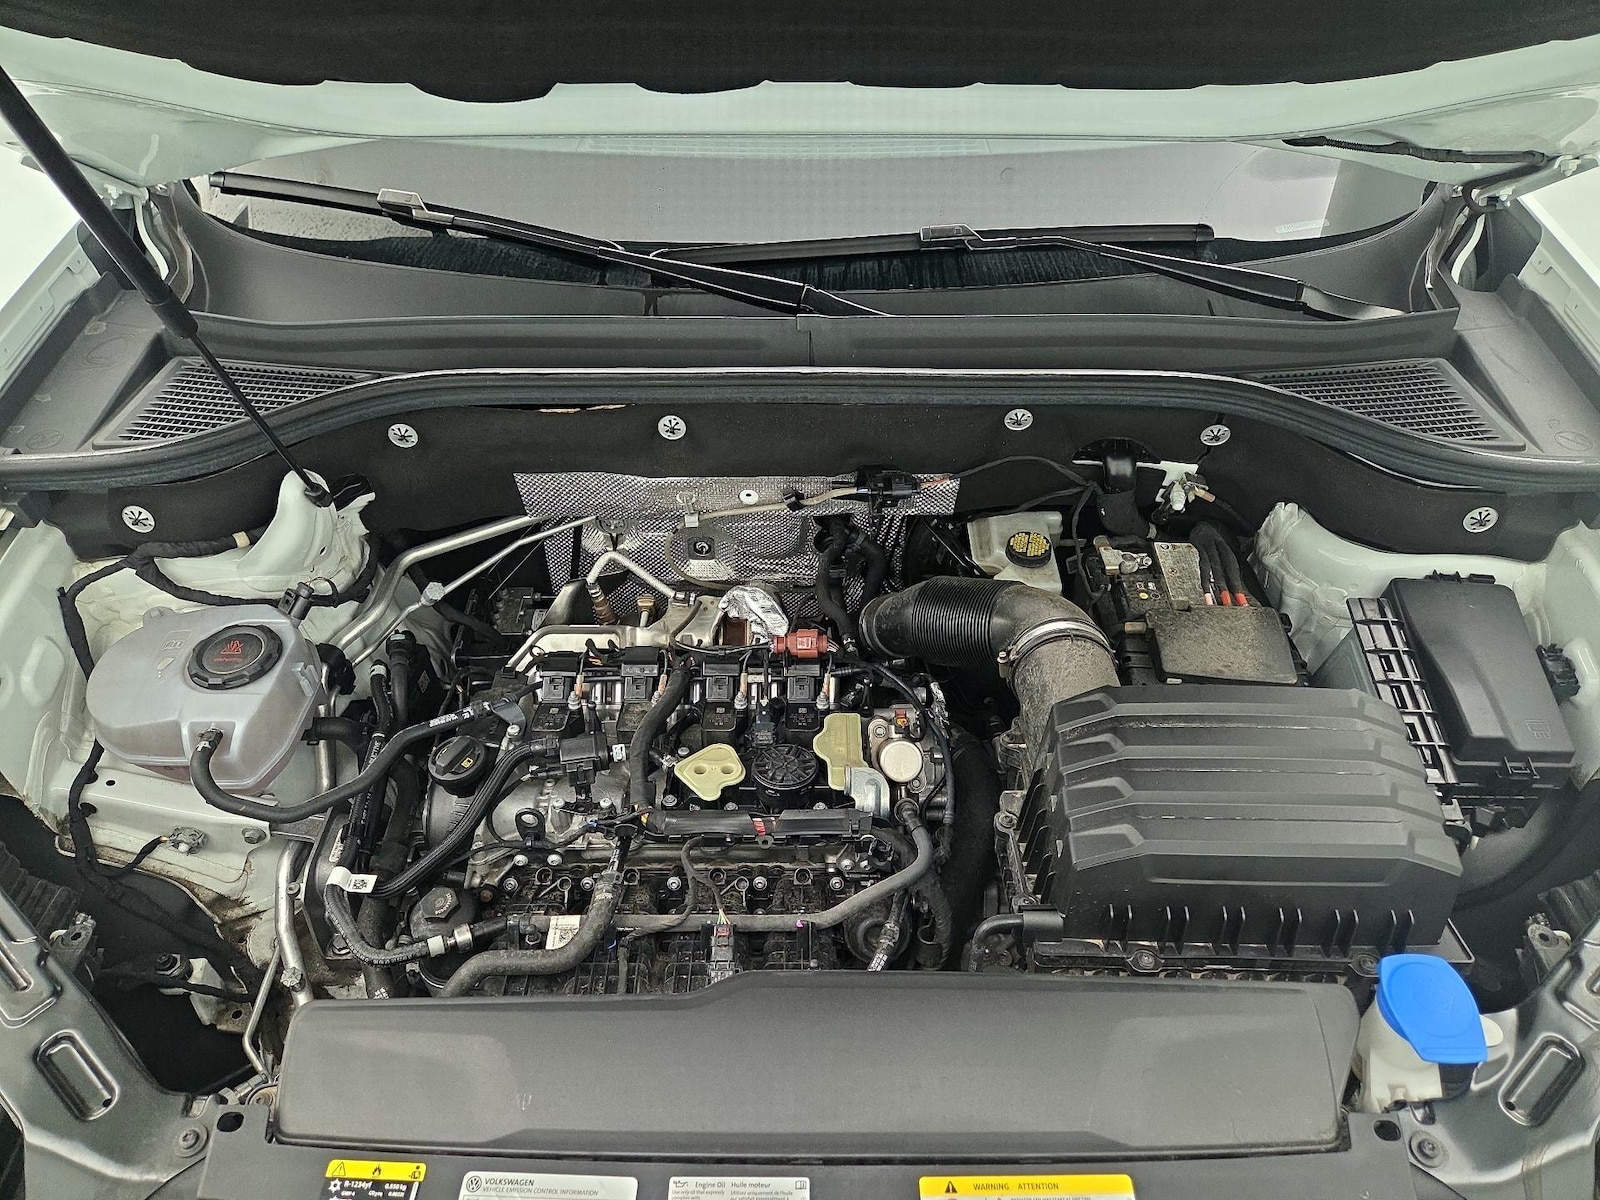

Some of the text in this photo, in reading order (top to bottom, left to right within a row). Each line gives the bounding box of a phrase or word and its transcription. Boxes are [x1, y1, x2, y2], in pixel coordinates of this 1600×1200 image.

[343, 1180, 373, 1190] R-1234yf
[484, 1178, 535, 1187] VOLKSWAGEN
[695, 1181, 716, 1190] Engine
[972, 1182, 1059, 1191] WARNING ATTENTION
